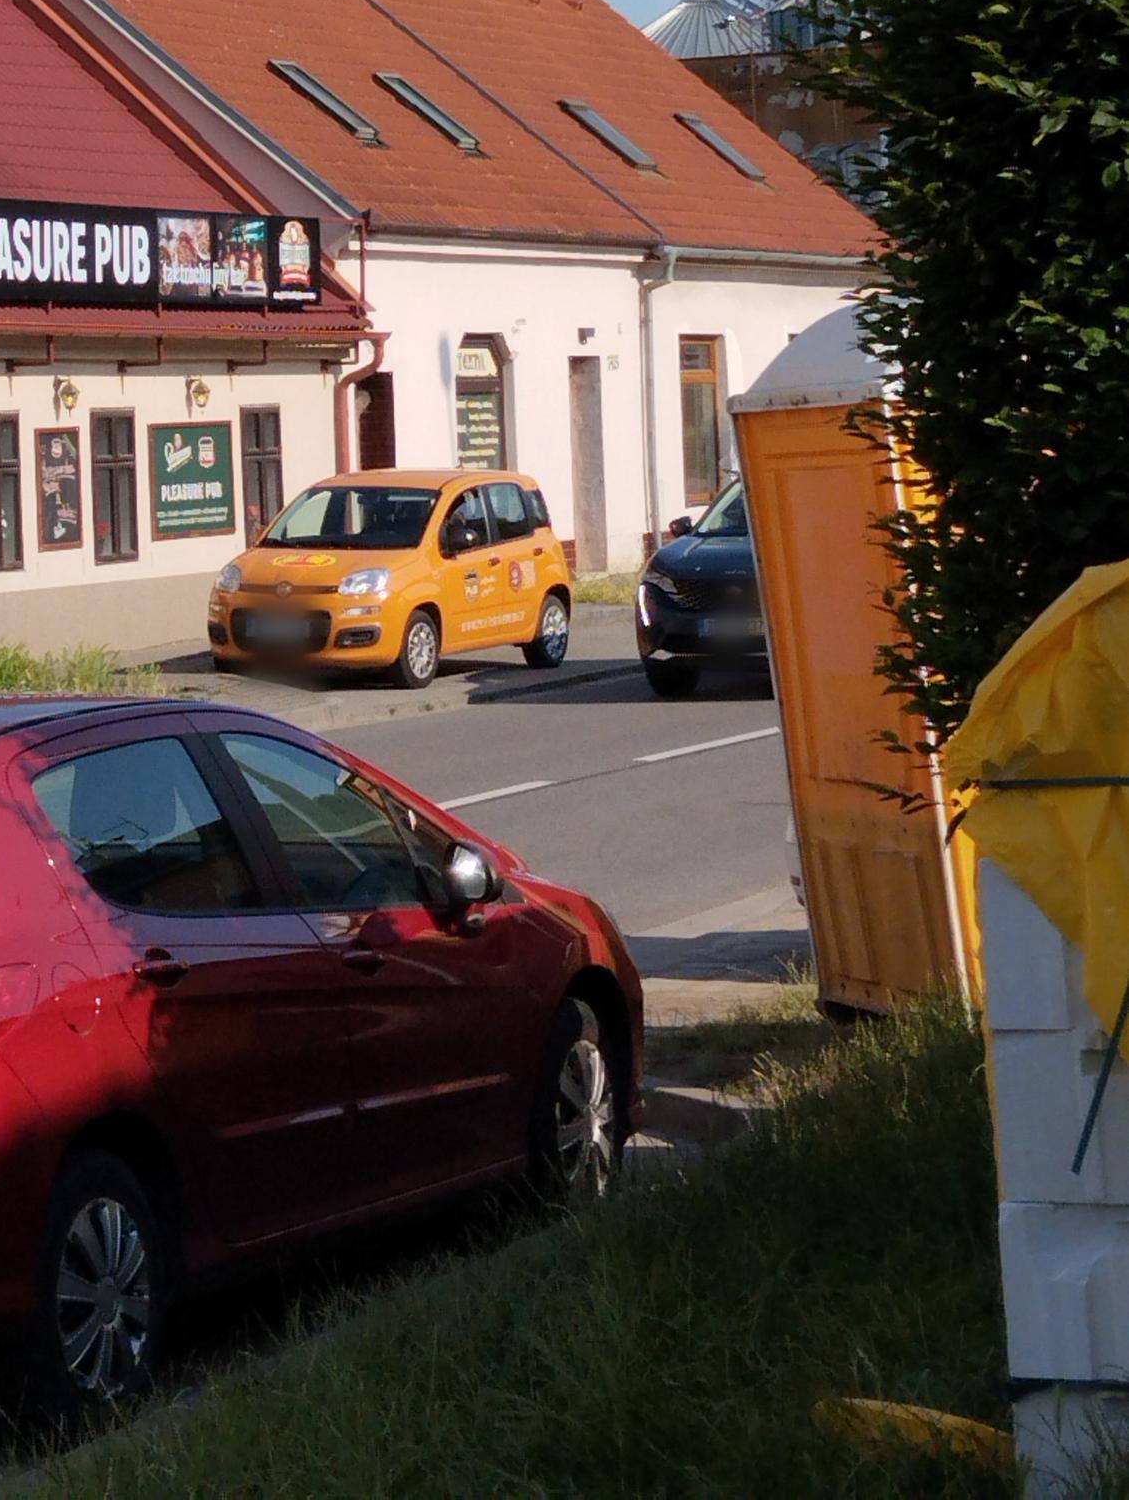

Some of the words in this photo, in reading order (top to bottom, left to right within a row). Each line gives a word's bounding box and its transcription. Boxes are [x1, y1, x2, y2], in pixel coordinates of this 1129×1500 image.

[94, 224, 151, 285] PUB
[161, 483, 204, 502] PLEASURE
[205, 481, 223, 499] PUB
